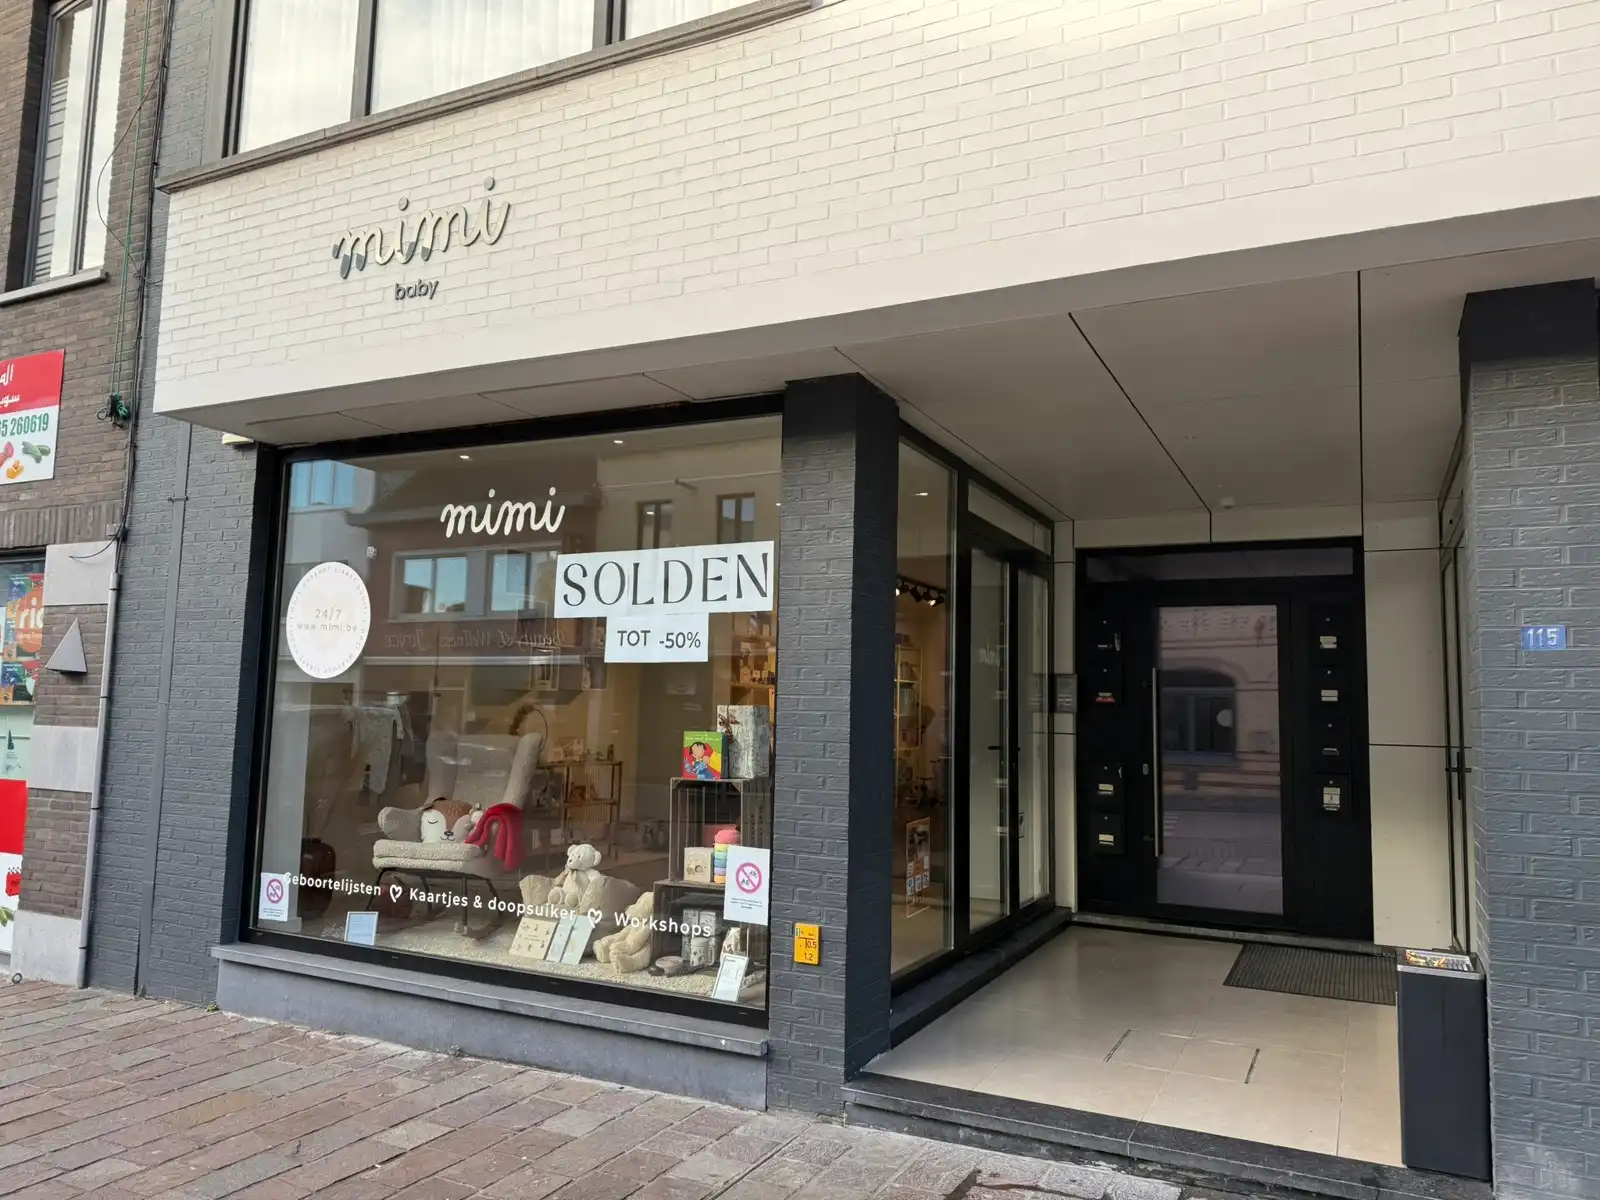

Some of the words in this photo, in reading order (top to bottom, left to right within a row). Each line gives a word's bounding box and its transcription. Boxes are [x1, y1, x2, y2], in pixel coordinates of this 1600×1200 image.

[332, 176, 511, 279] mimi
[395, 279, 439, 300] baby
[10, 412, 50, 436] 260619
[440, 487, 566, 538] mimi
[563, 552, 768, 607] SOLDEN
[315, 607, 342, 622] 24/7
[296, 622, 357, 633] www.mimi.be
[1527, 628, 1559, 648] 115
[617, 630, 651, 647] TOT
[659, 630, 701, 649] -50%
[284, 872, 382, 896] Geboortelijsten
[410, 888, 468, 908] Kaartjes
[474, 895, 483, 909] &
[488, 897, 577, 921] doopsuiker
[614, 911, 712, 937] Workshops
